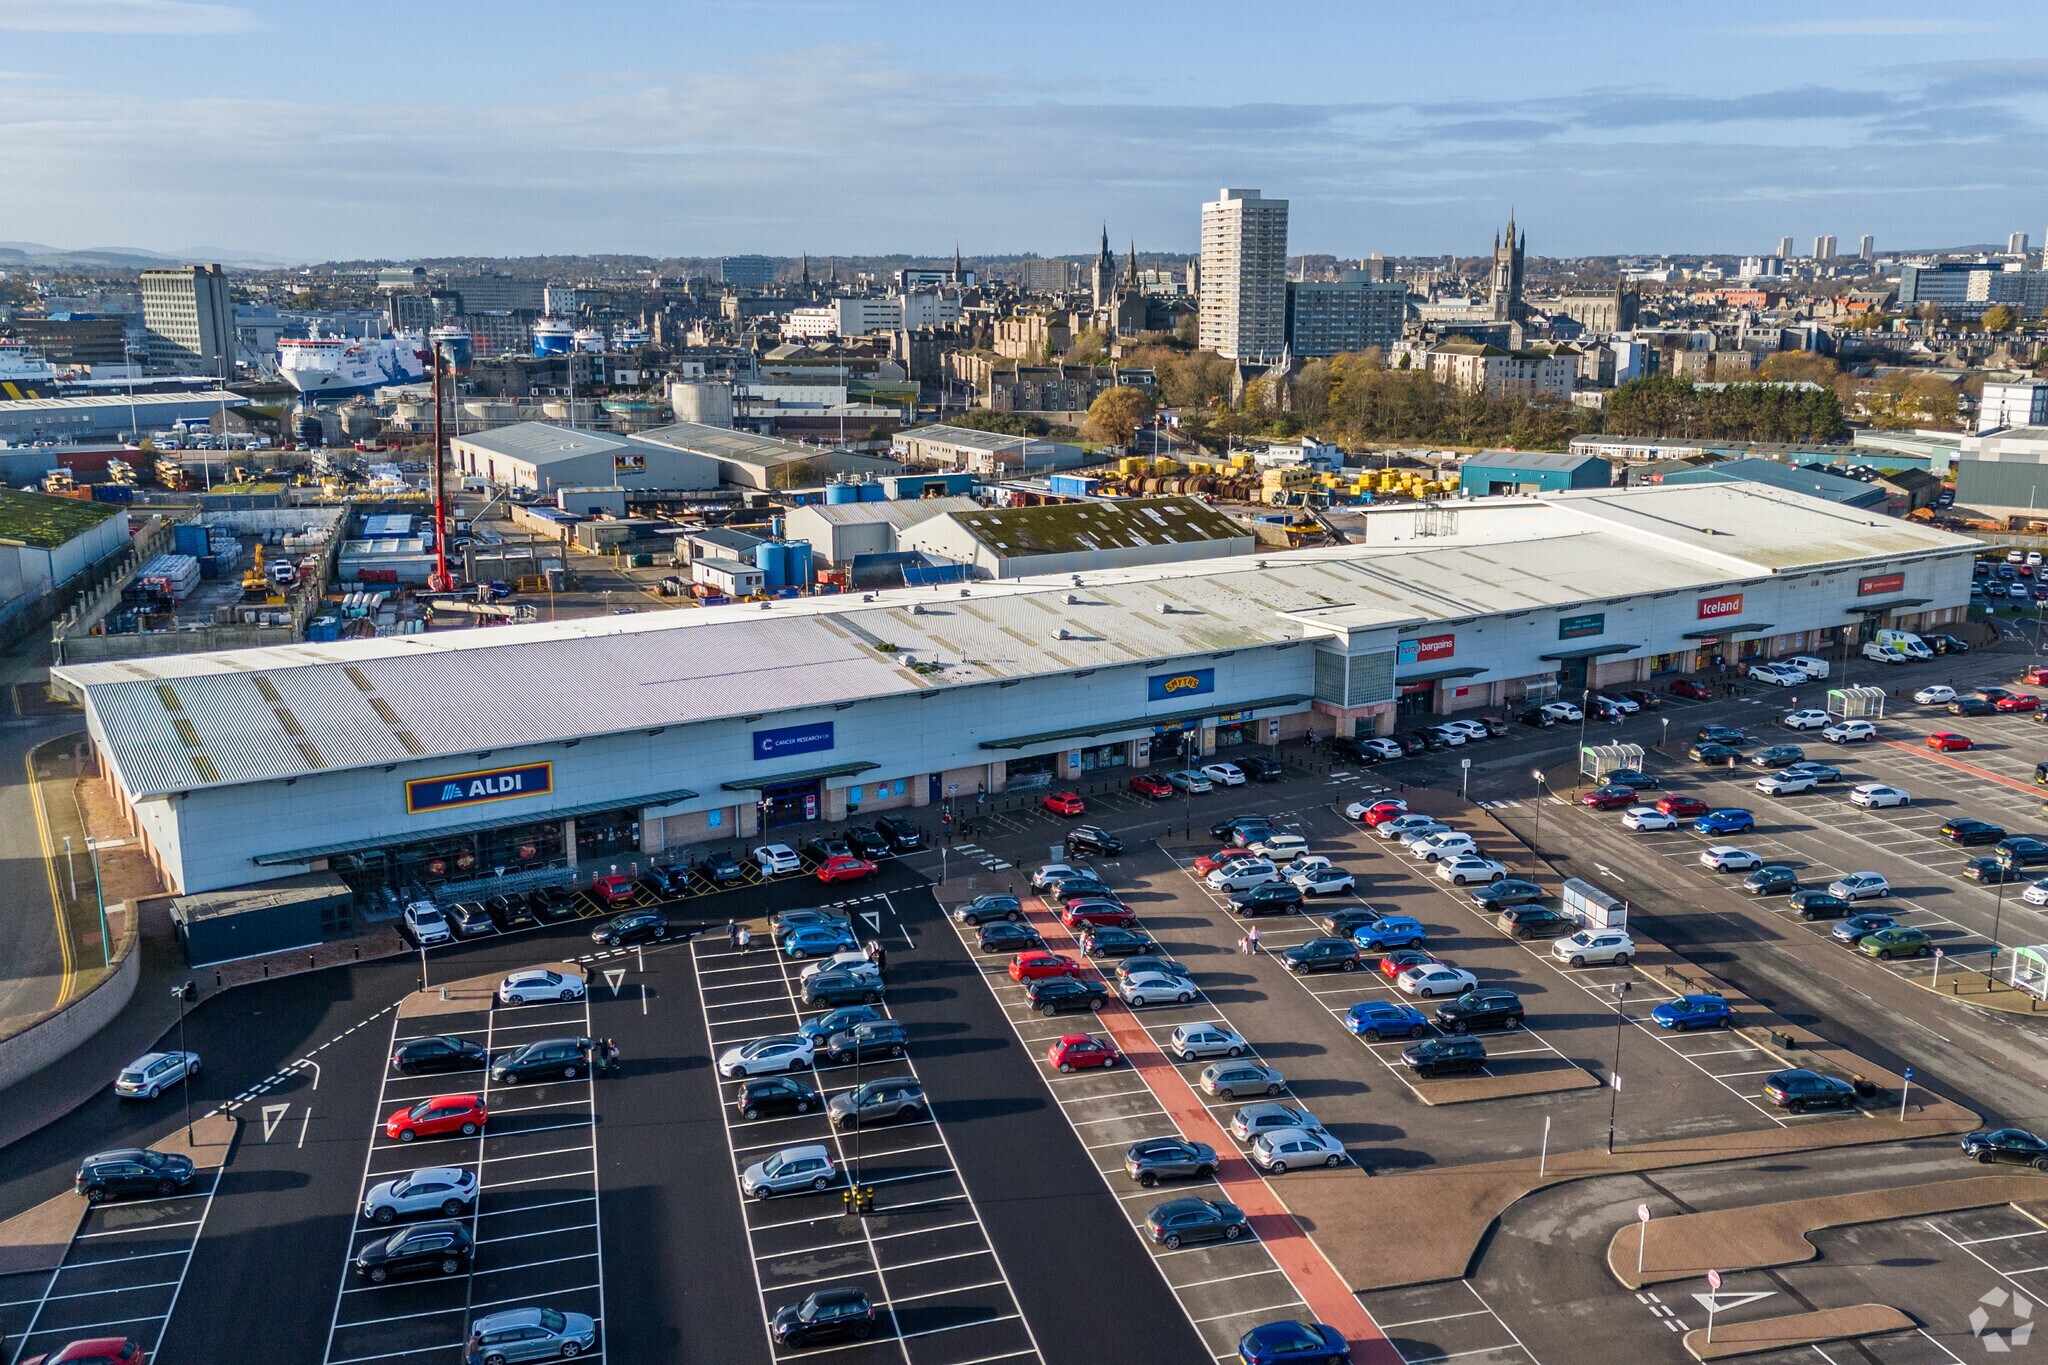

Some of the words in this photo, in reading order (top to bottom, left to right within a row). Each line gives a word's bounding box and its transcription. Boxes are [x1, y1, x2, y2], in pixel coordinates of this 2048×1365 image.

[615, 456, 644, 468] MKM
[1703, 599, 1739, 615] Iceland
[1421, 640, 1453, 652] bargains
[1166, 676, 1199, 692] SMYTHS
[796, 734, 821, 743] RESEARCH
[468, 774, 522, 798] ALDI
